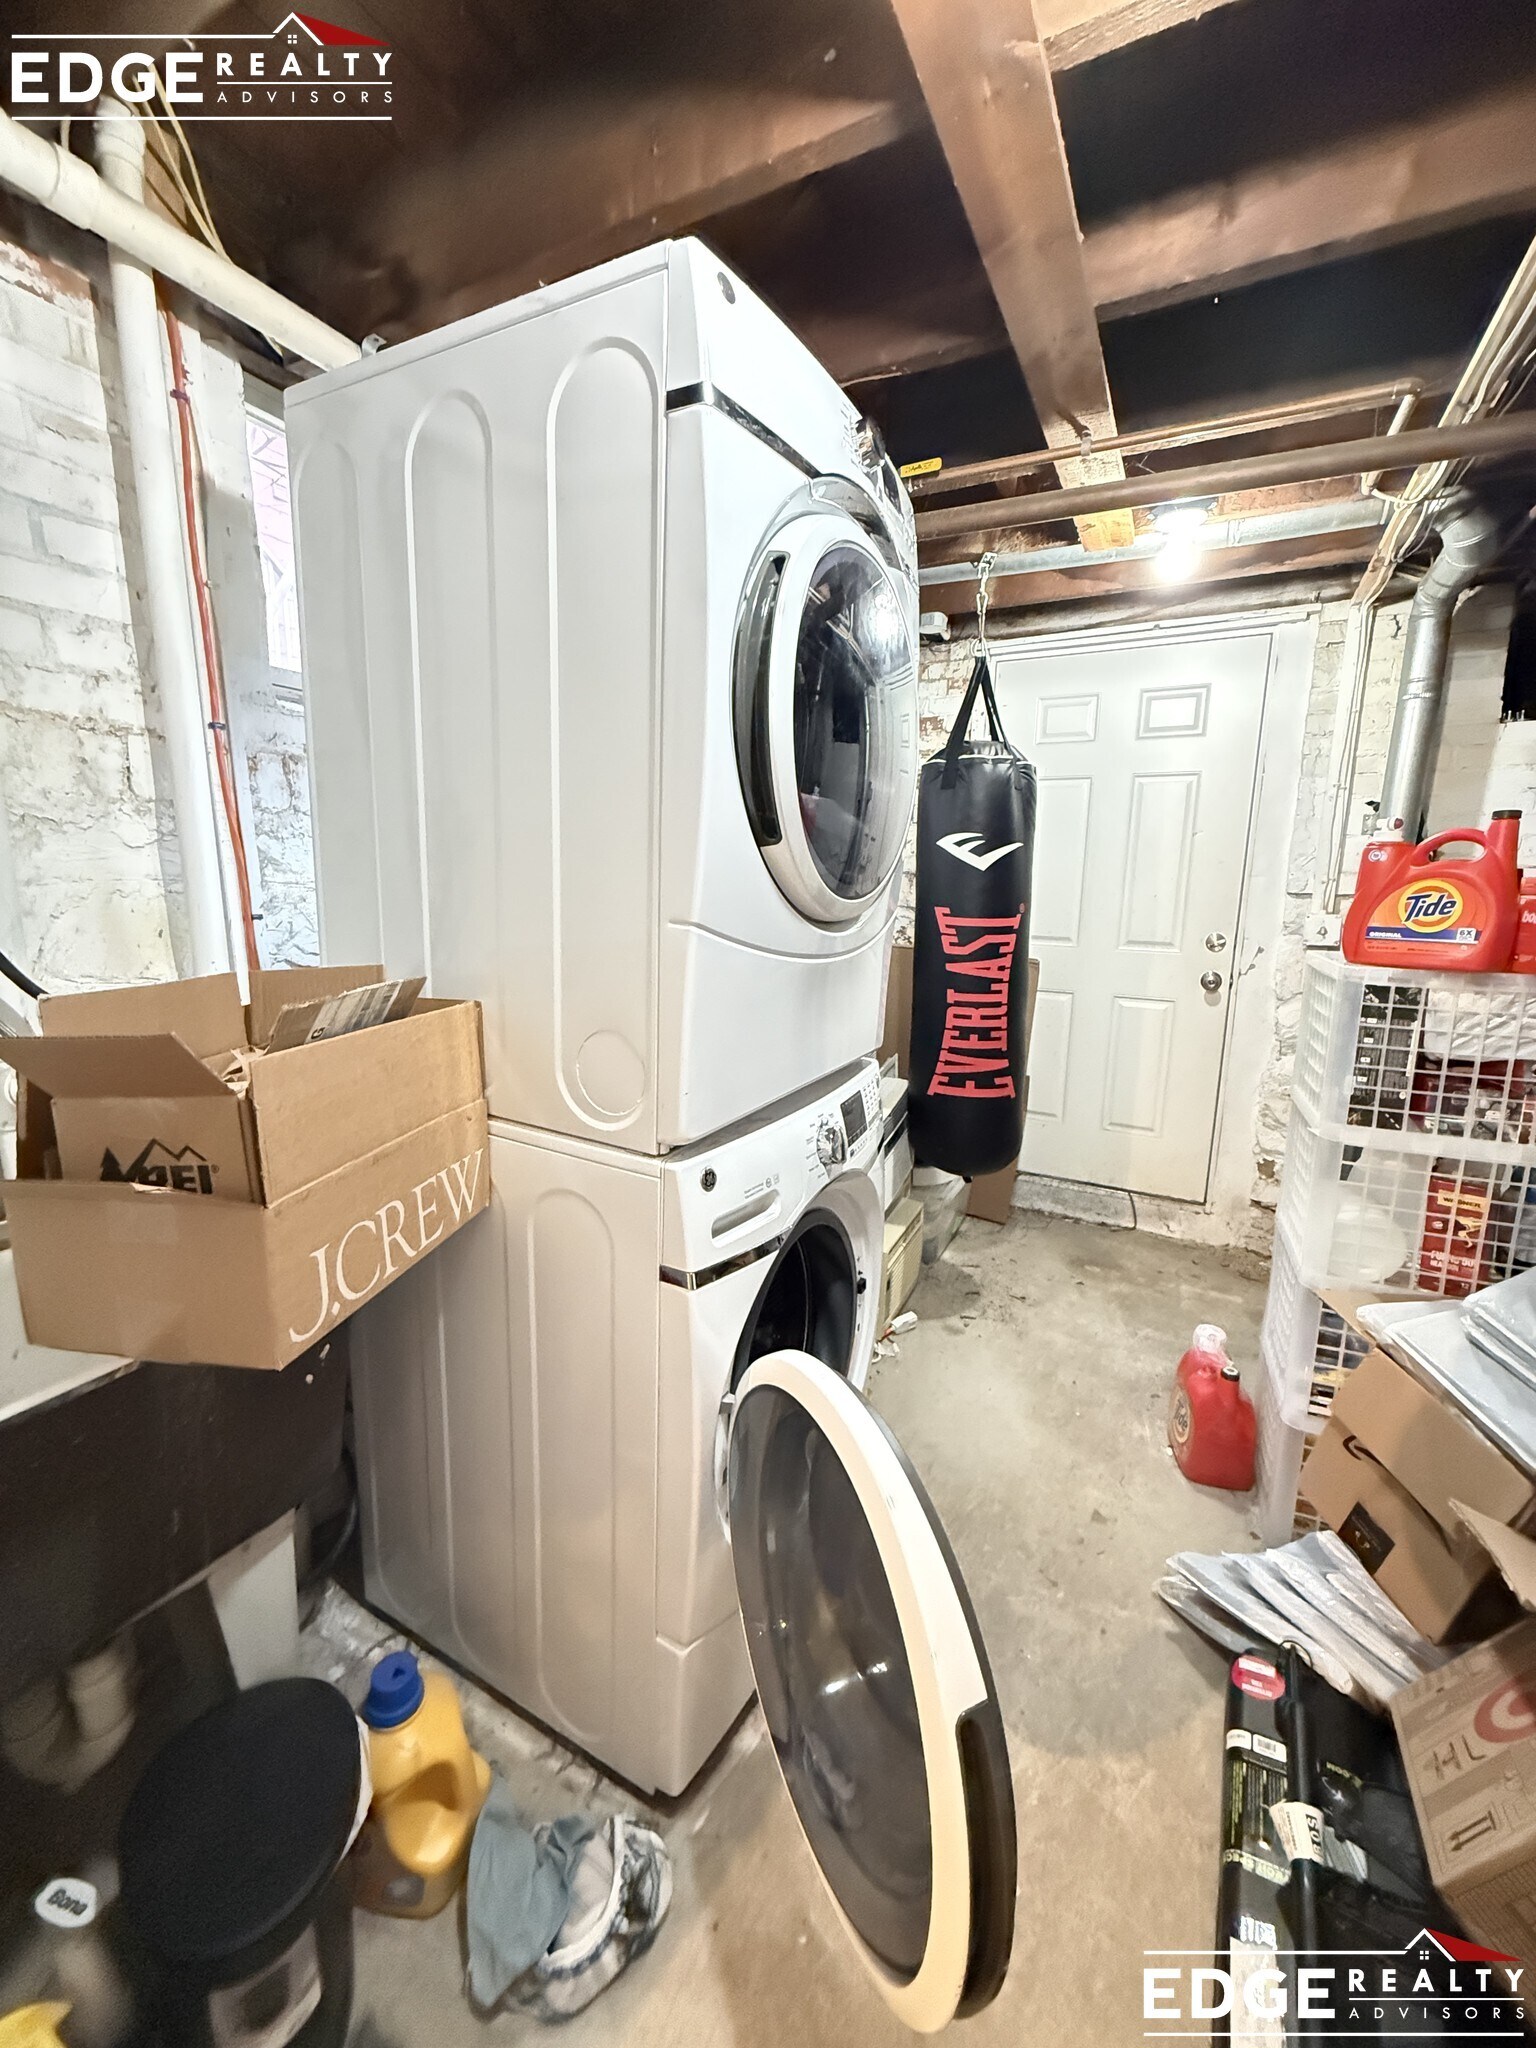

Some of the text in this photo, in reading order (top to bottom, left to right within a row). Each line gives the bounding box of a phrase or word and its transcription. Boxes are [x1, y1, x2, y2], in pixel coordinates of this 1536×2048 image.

[1404, 893, 1457, 922] Tide
[927, 905, 1021, 1100] EVERLAST
[289, 1149, 483, 1343] J.CREW
[1174, 1399, 1189, 1431] Tide
